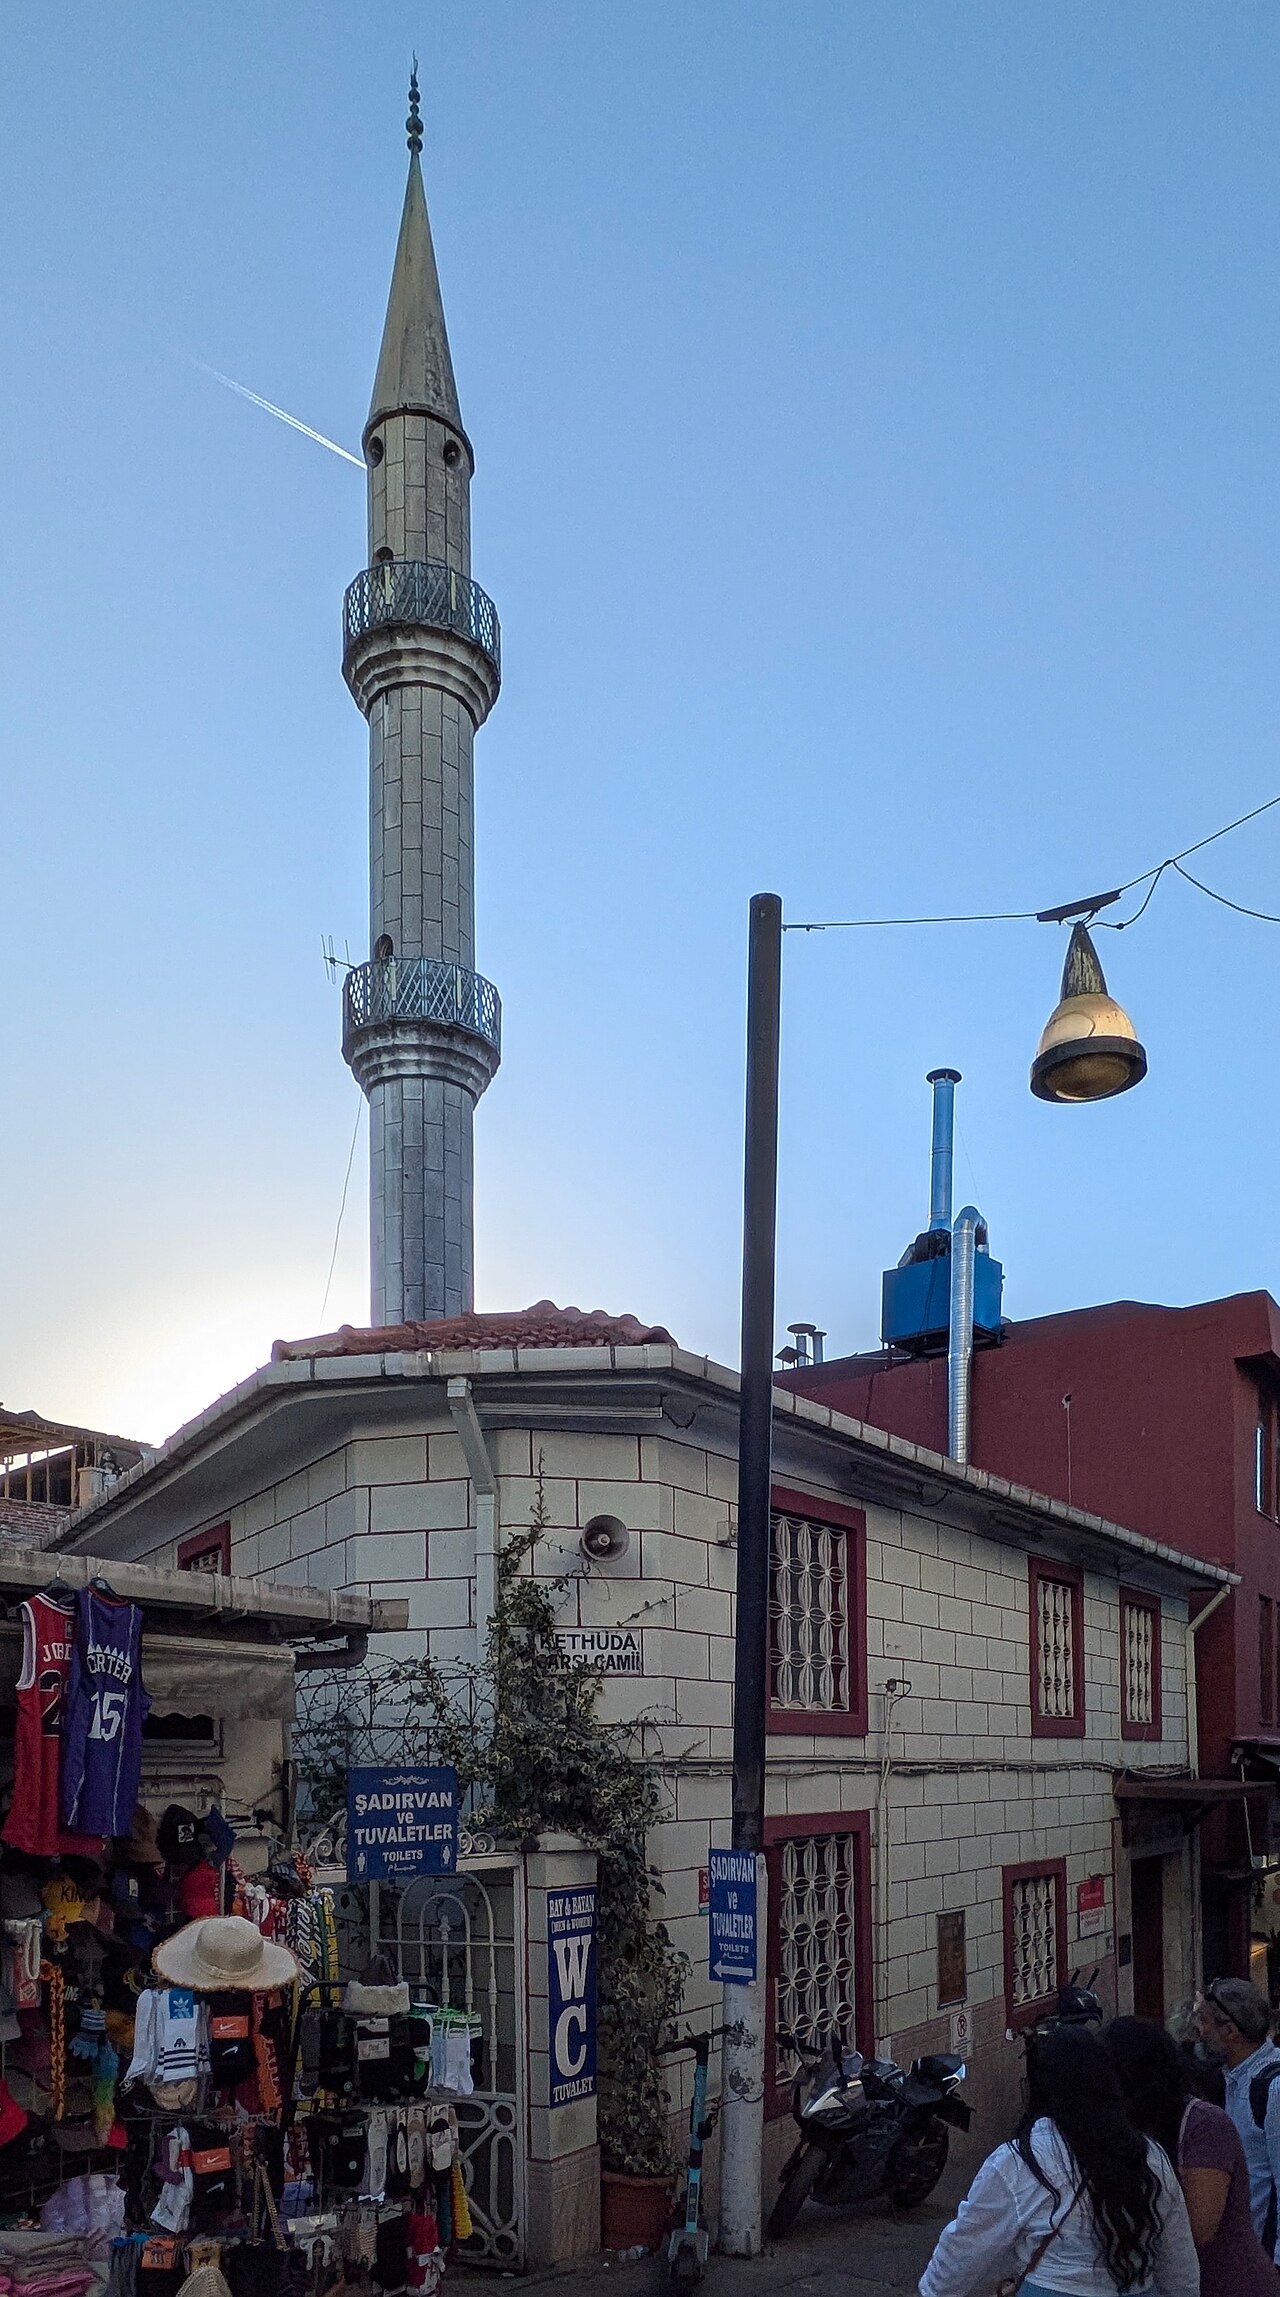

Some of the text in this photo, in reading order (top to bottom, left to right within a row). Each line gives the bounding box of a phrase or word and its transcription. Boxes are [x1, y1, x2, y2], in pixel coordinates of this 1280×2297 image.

[87, 1691, 126, 1741] 15
[355, 1792, 453, 1816] ŞADIRVAN
[397, 1812, 414, 1824] ve
[354, 1823, 453, 1846] TUVALETLER
[382, 1850, 423, 1862] TOILETS
[711, 1855, 754, 1888] ŞADIRVAN
[549, 1894, 595, 1918] BAY & BAYAN
[727, 1891, 738, 1910] ve
[712, 1912, 754, 1939] TUVALETLER
[719, 1943, 749, 1953] TOILETS
[553, 2076, 593, 2103] TUVALET
